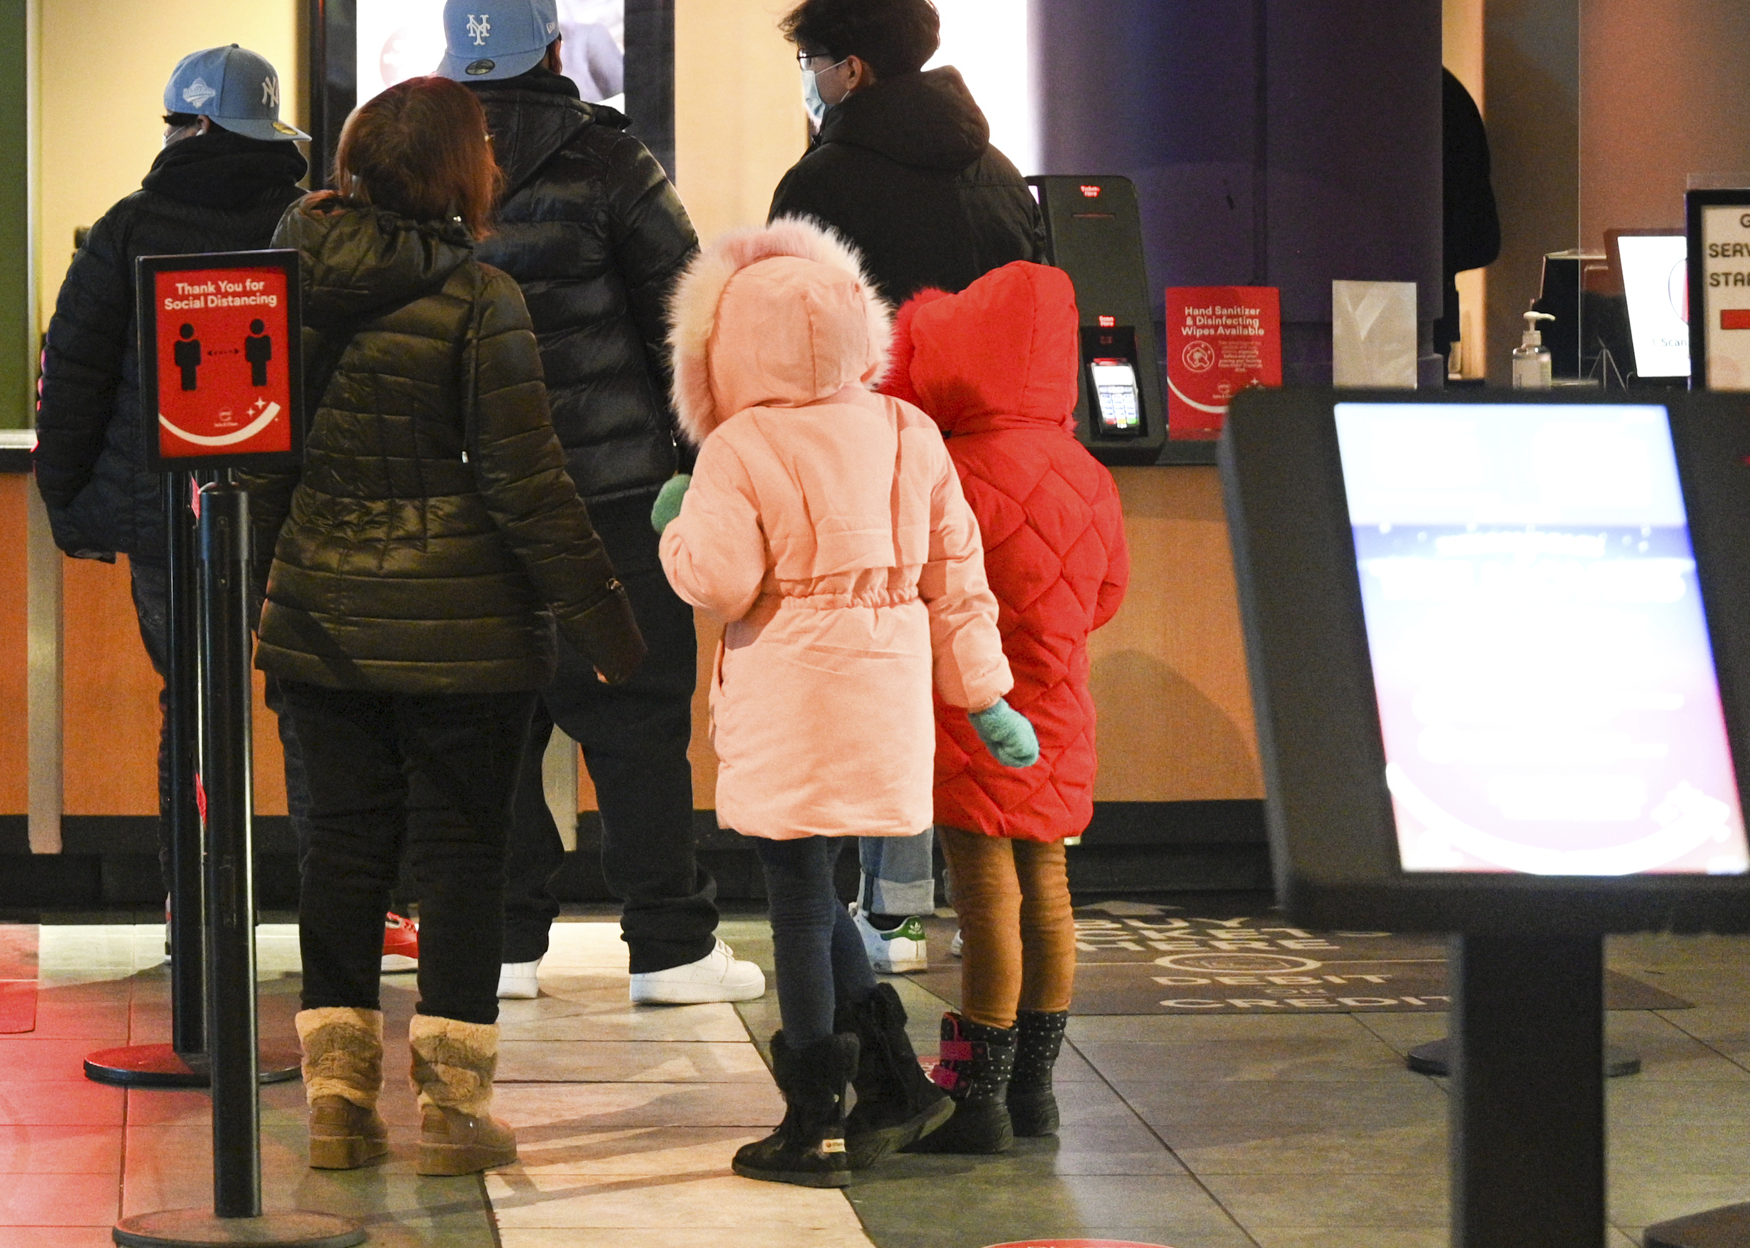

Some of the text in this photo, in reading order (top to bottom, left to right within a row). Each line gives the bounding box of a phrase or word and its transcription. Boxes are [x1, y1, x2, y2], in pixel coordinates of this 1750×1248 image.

[466, 14, 491, 46] NY
[1740, 213, 1750, 229] G
[1709, 243, 1750, 258] SERV
[176, 279, 265, 295] Thank You for
[164, 293, 277, 310] Social Distancing
[1185, 305, 1260, 316] Hand Sanitizer
[1186, 316, 1259, 328] & Disinfecting
[1181, 326, 1265, 338] Wipes Available
[1076, 917, 1250, 929] BUY
[1151, 974, 1394, 986] DEBIT
